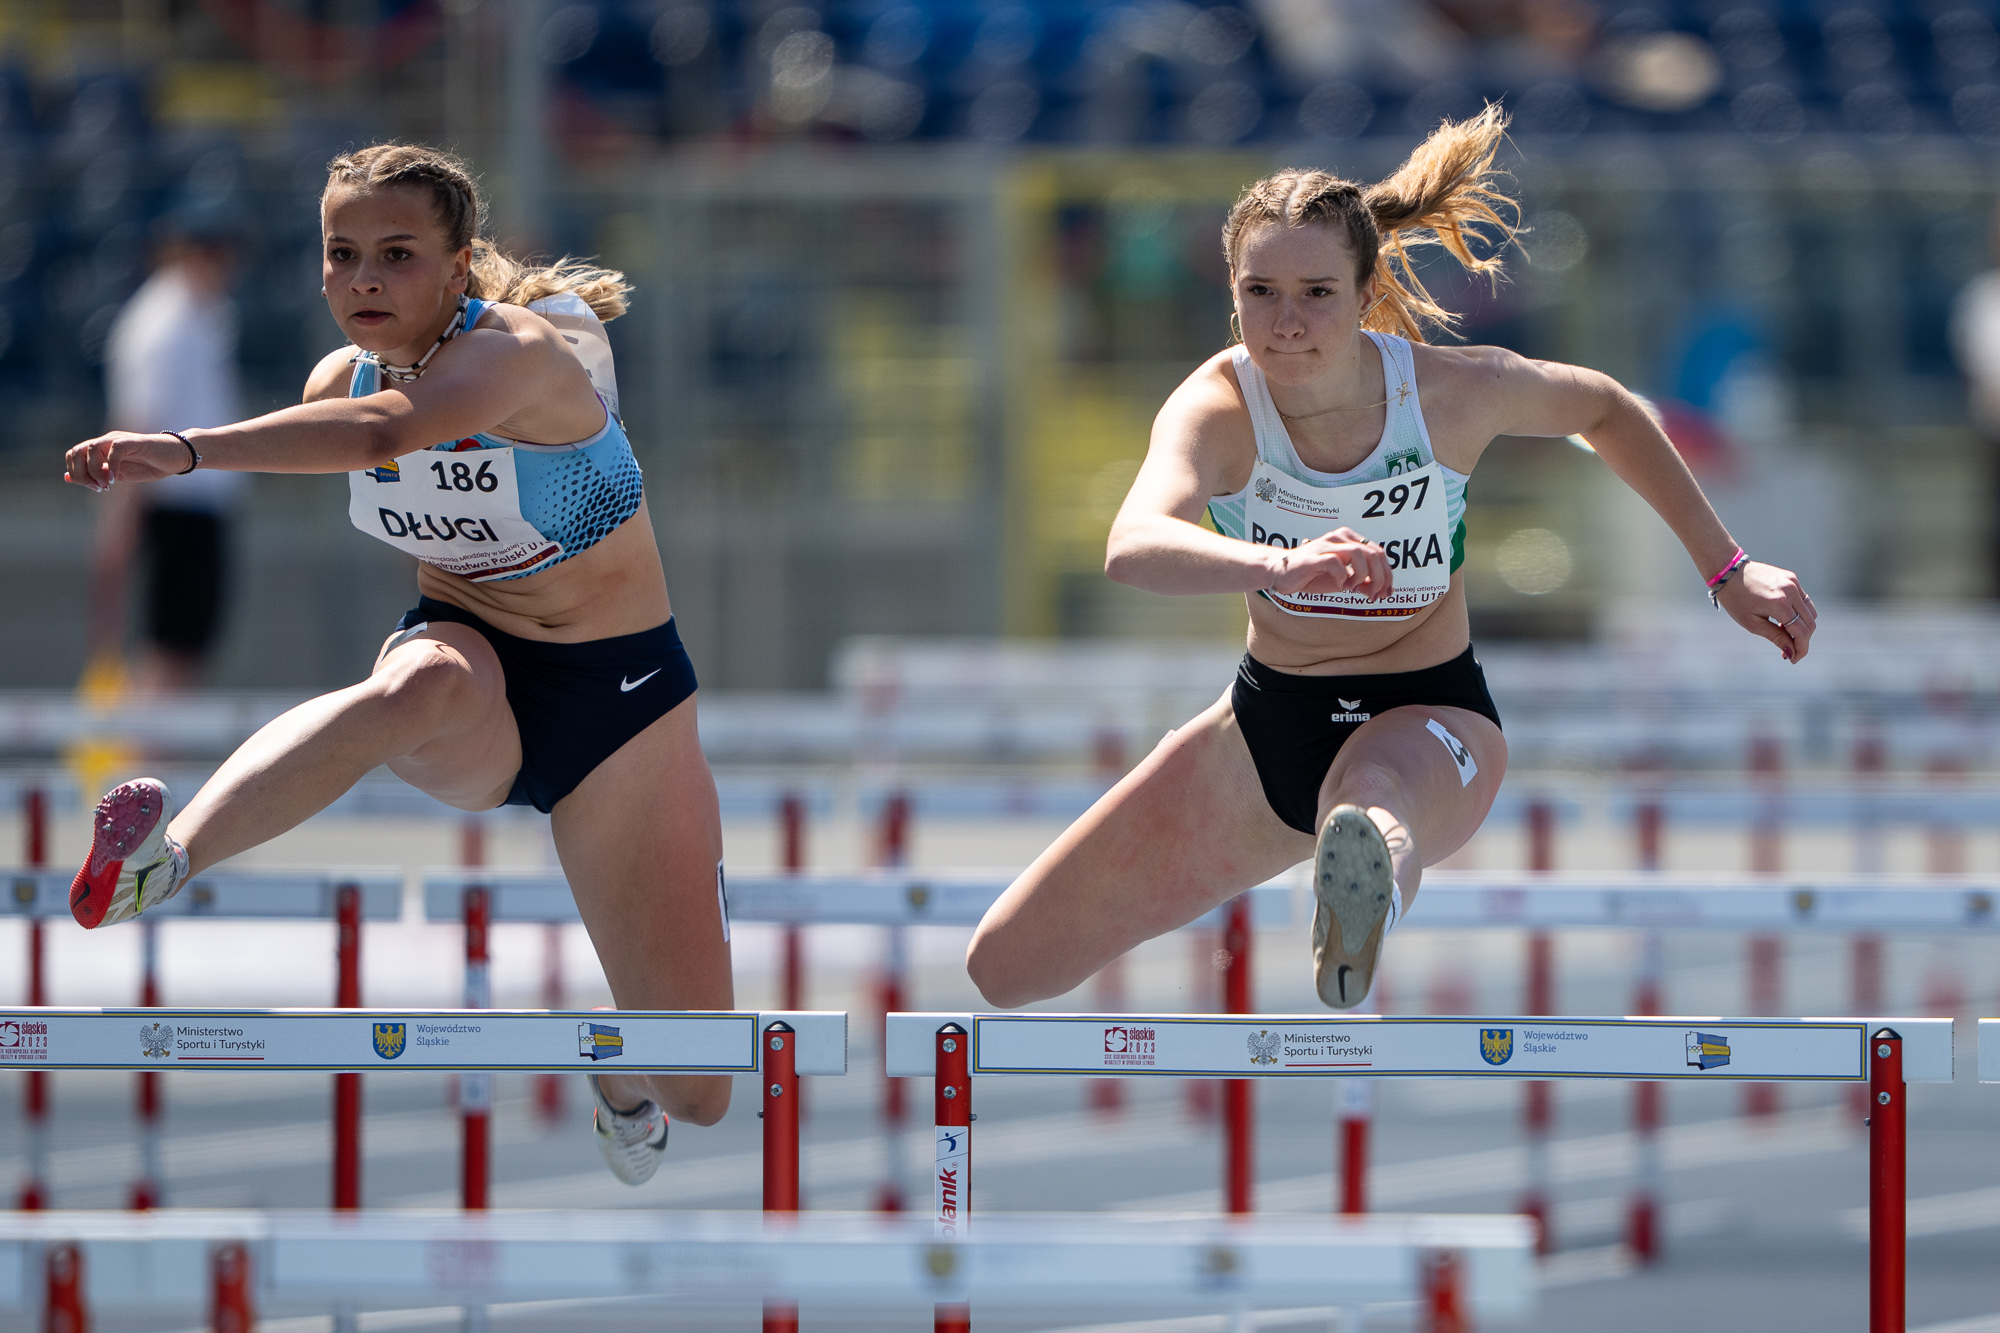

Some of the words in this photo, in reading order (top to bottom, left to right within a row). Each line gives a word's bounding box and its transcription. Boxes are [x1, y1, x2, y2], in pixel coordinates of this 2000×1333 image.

[1384, 446, 1418, 460] WARSZAWA
[430, 460, 498, 492] 186
[1278, 488, 1324, 506] Ministerstwo
[1362, 475, 1430, 518] 297
[1276, 496, 1300, 508] Sportu
[1306, 505, 1340, 514] Turystyki
[378, 507, 500, 542] DŁUGI
[490, 547, 528, 566] Polski
[1272, 595, 1312, 612] HORZÓW
[1331, 712, 1370, 722] erima
[177, 1026, 244, 1036] Ministerstwo
[416, 1024, 481, 1035] Województwo
[1129, 1027, 1155, 1041] śląskie
[1523, 1030, 1588, 1041] Województwo
[22, 1036, 48, 1048] 2023
[416, 1036, 450, 1048] Śląskie
[1284, 1034, 1350, 1043] Ministerstwo
[176, 1040, 210, 1050] Sportu
[219, 1040, 265, 1050] Turystyki
[1129, 1042, 1155, 1053] 2023
[1523, 1042, 1556, 1054] Śląskie
[1284, 1046, 1318, 1057] Sportu
[1326, 1046, 1372, 1057] Turystyki
[938, 1167, 958, 1240] olanik
